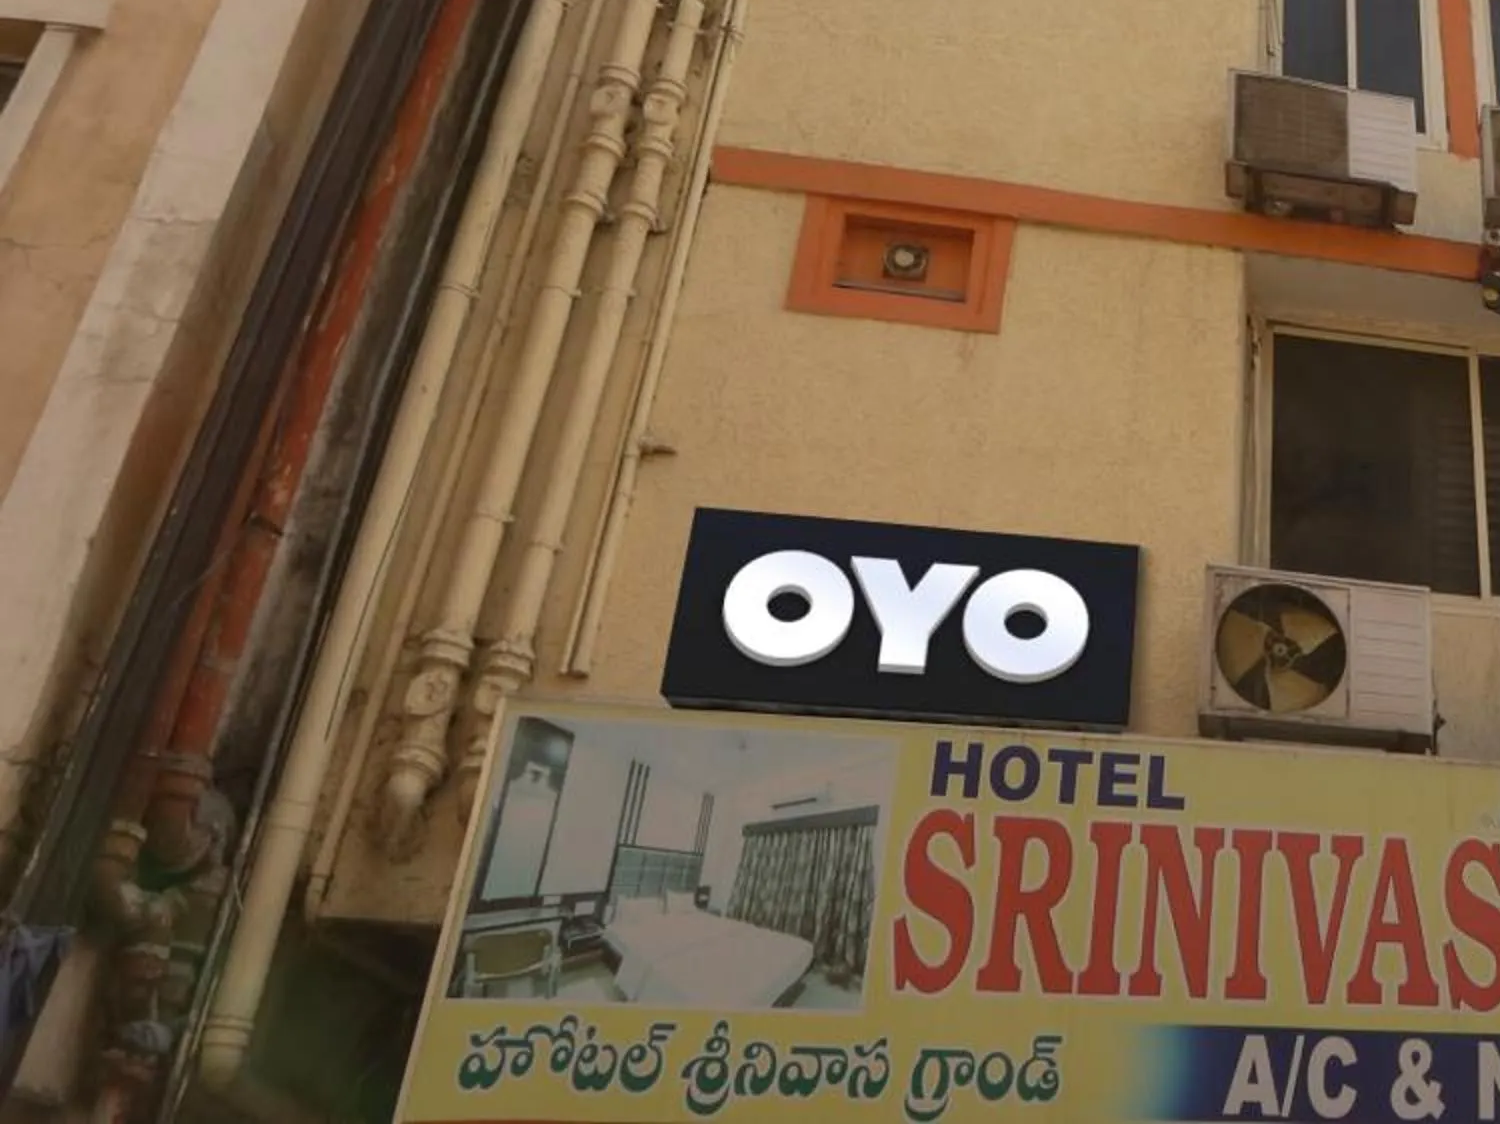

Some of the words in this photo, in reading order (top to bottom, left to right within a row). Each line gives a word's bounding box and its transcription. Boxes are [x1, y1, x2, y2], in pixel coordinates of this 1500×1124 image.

[723, 549, 1090, 683] OYO
[930, 740, 1185, 811] HOTEL
[458, 1014, 676, 1092] హోటల్
[681, 1019, 889, 1115] శ్రీనివాస
[904, 1035, 1063, 1122] గ్రాండ్
[1222, 1034, 1358, 1119] A/C
[1390, 1038, 1446, 1120] &
